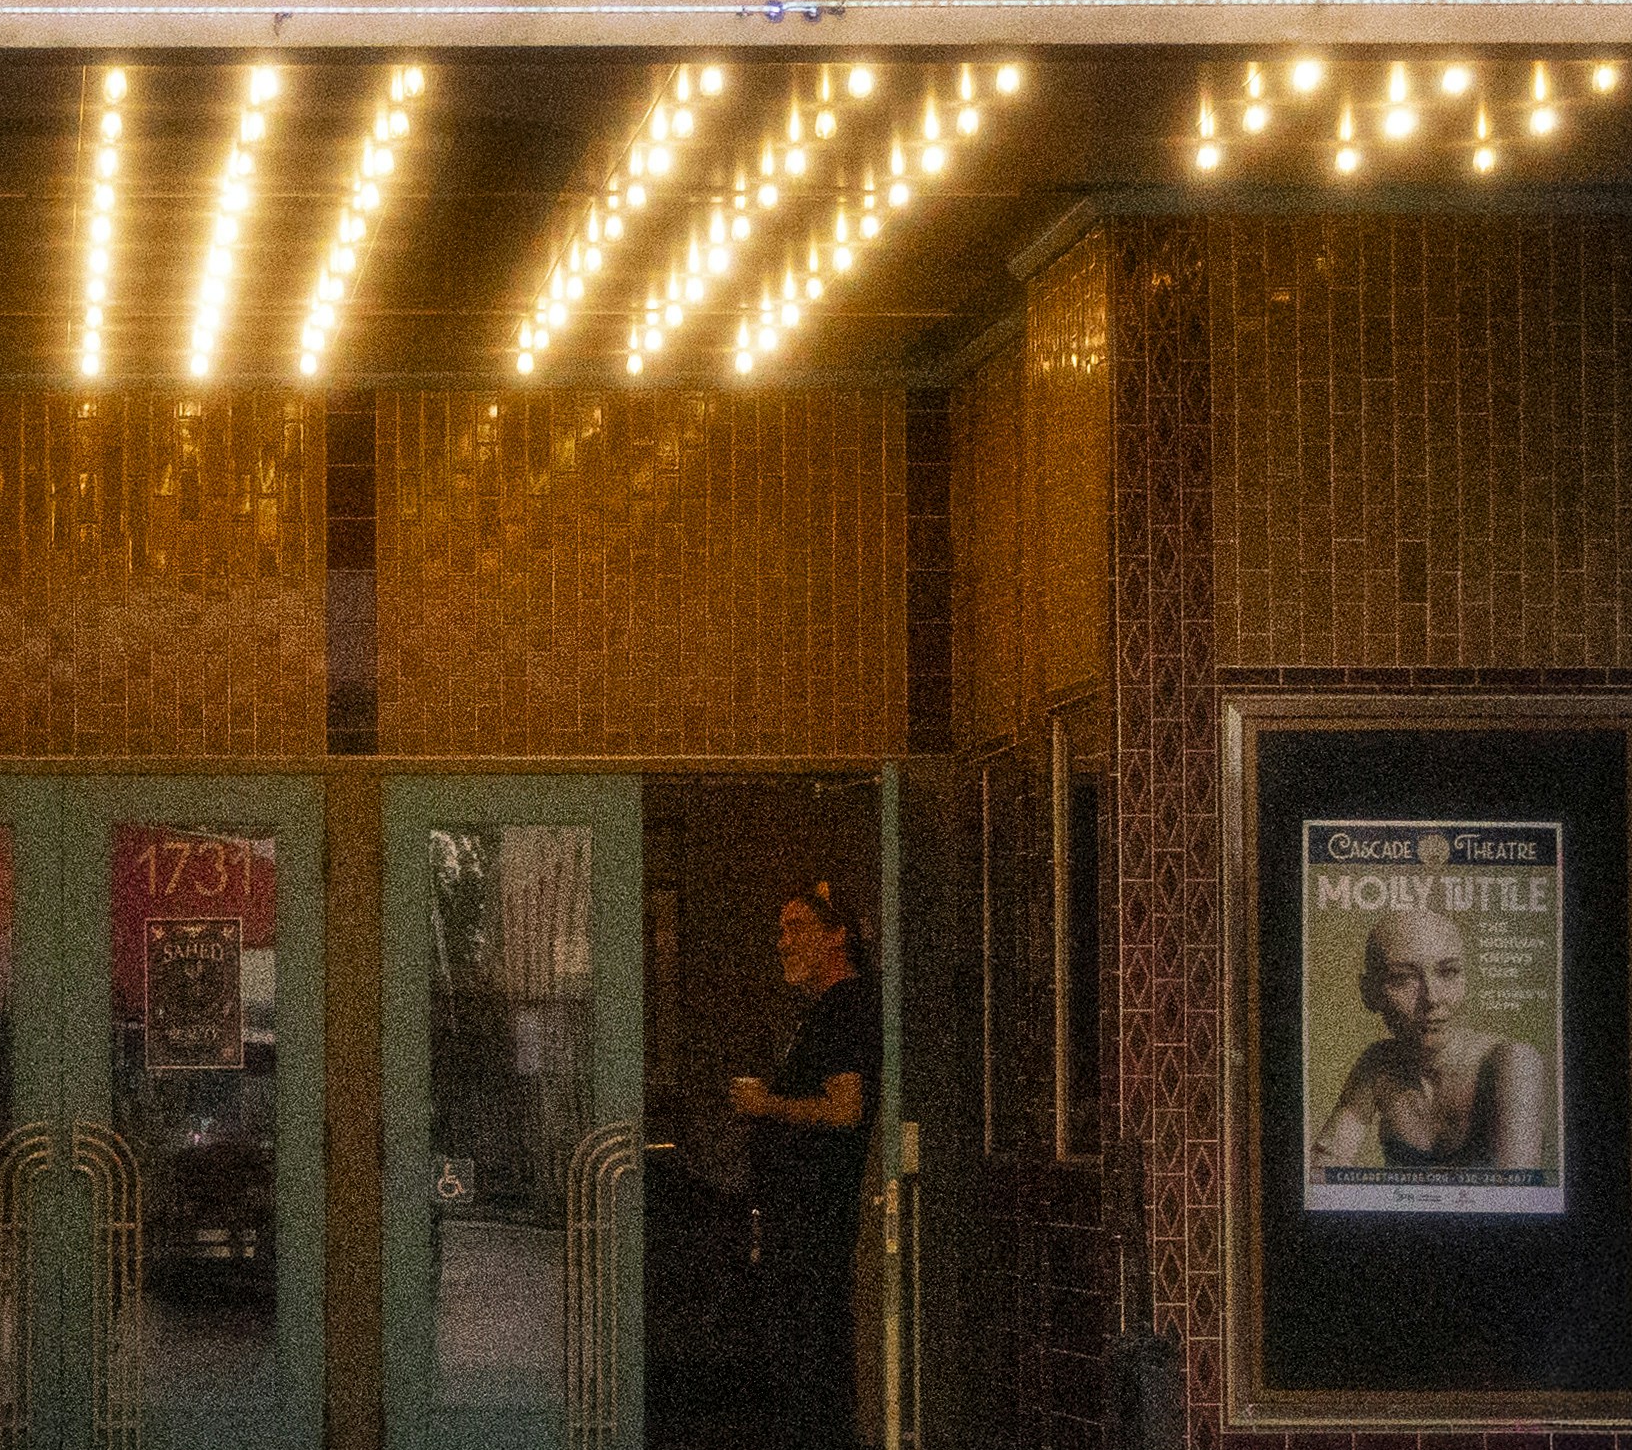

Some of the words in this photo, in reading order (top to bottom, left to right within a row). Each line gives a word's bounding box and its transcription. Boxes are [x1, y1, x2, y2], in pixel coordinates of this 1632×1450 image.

[1328, 832, 1412, 861] CASCADE
[1454, 833, 1537, 861] THEATRE
[137, 842, 252, 896] 1731
[1317, 875, 1434, 912] MOLLY
[1439, 875, 1548, 912] TUTTLE
